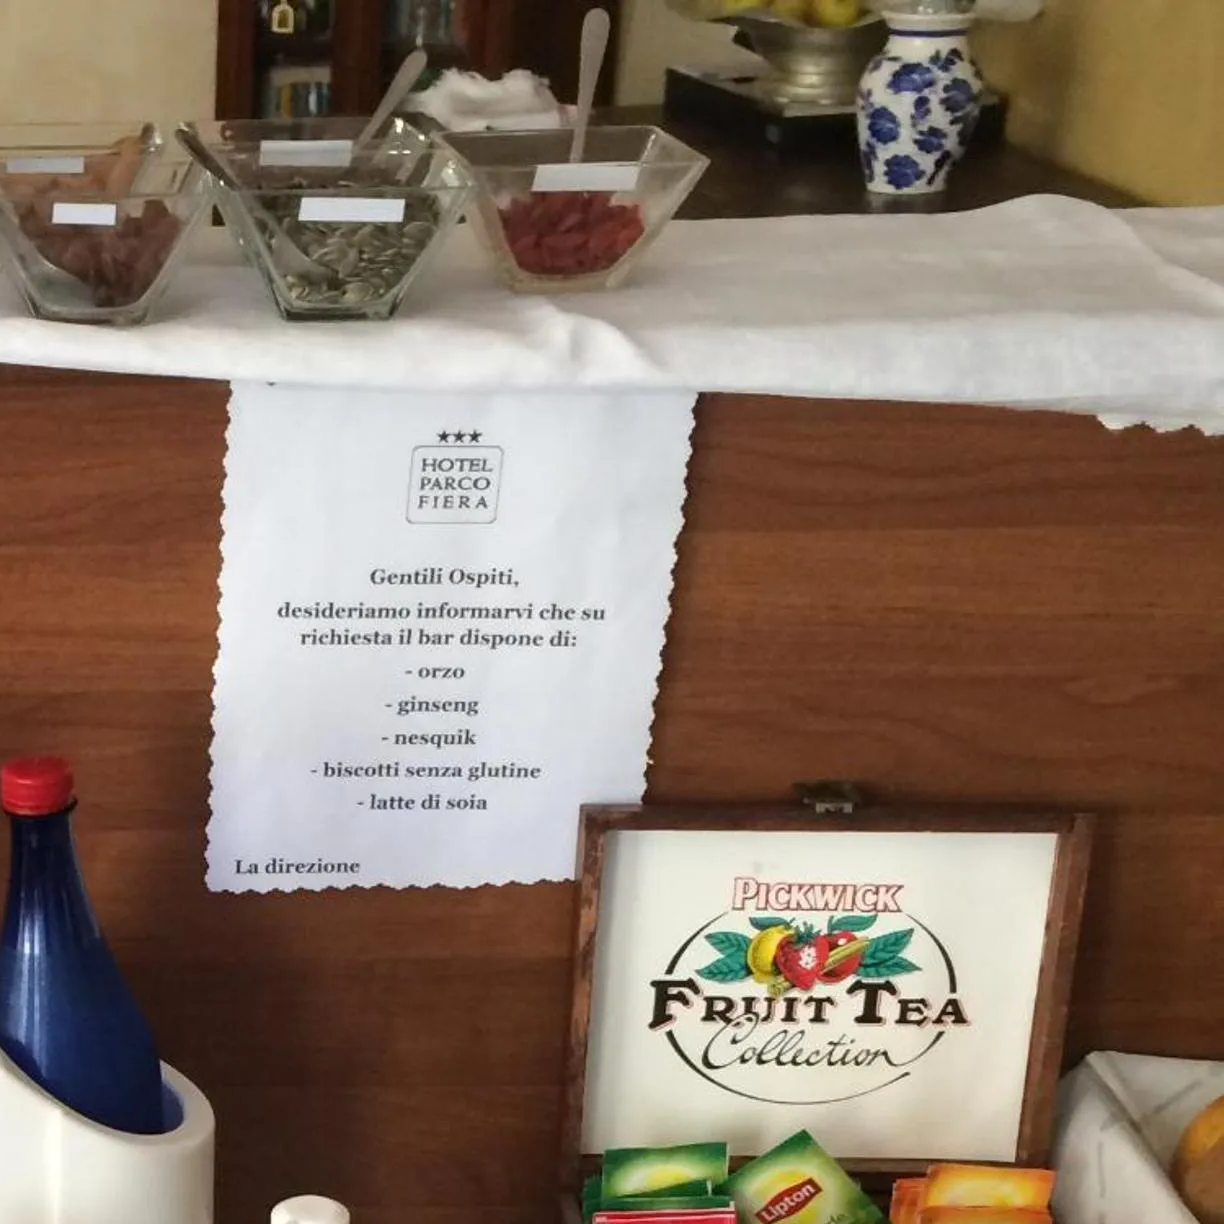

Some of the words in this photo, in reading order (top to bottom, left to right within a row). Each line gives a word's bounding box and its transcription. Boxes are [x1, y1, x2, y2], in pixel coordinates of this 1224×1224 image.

[420, 456, 495, 473] HOTEL
[418, 475, 493, 492] PARCO
[416, 494, 490, 511] FIERA
[369, 567, 444, 586] Gentili
[448, 567, 520, 589] Ospiti,
[276, 601, 412, 620] desideriamo
[416, 601, 534, 620] informarvi
[538, 602, 577, 621] che
[580, 608, 606, 621] su
[300, 628, 393, 646] richiesta
[398, 627, 413, 646] il
[417, 627, 455, 646] bar
[459, 627, 545, 651] dispone
[548, 629, 578, 648] di:
[417, 666, 466, 680] orzo
[396, 695, 480, 717] ginseng
[393, 728, 477, 750] nesquik
[322, 761, 400, 778] biscotti
[404, 766, 463, 778] senza
[467, 761, 542, 782] glutine
[368, 793, 416, 811] latte
[421, 793, 441, 811] di
[445, 793, 488, 811] soia
[235, 858, 260, 875] La
[264, 857, 361, 875] direzione
[732, 877, 903, 913] PICKWICK
[648, 979, 837, 1031] FRUIT
[847, 980, 972, 1027] TEA
[701, 1012, 906, 1070] Collection
[759, 1183, 816, 1222] Lipton
